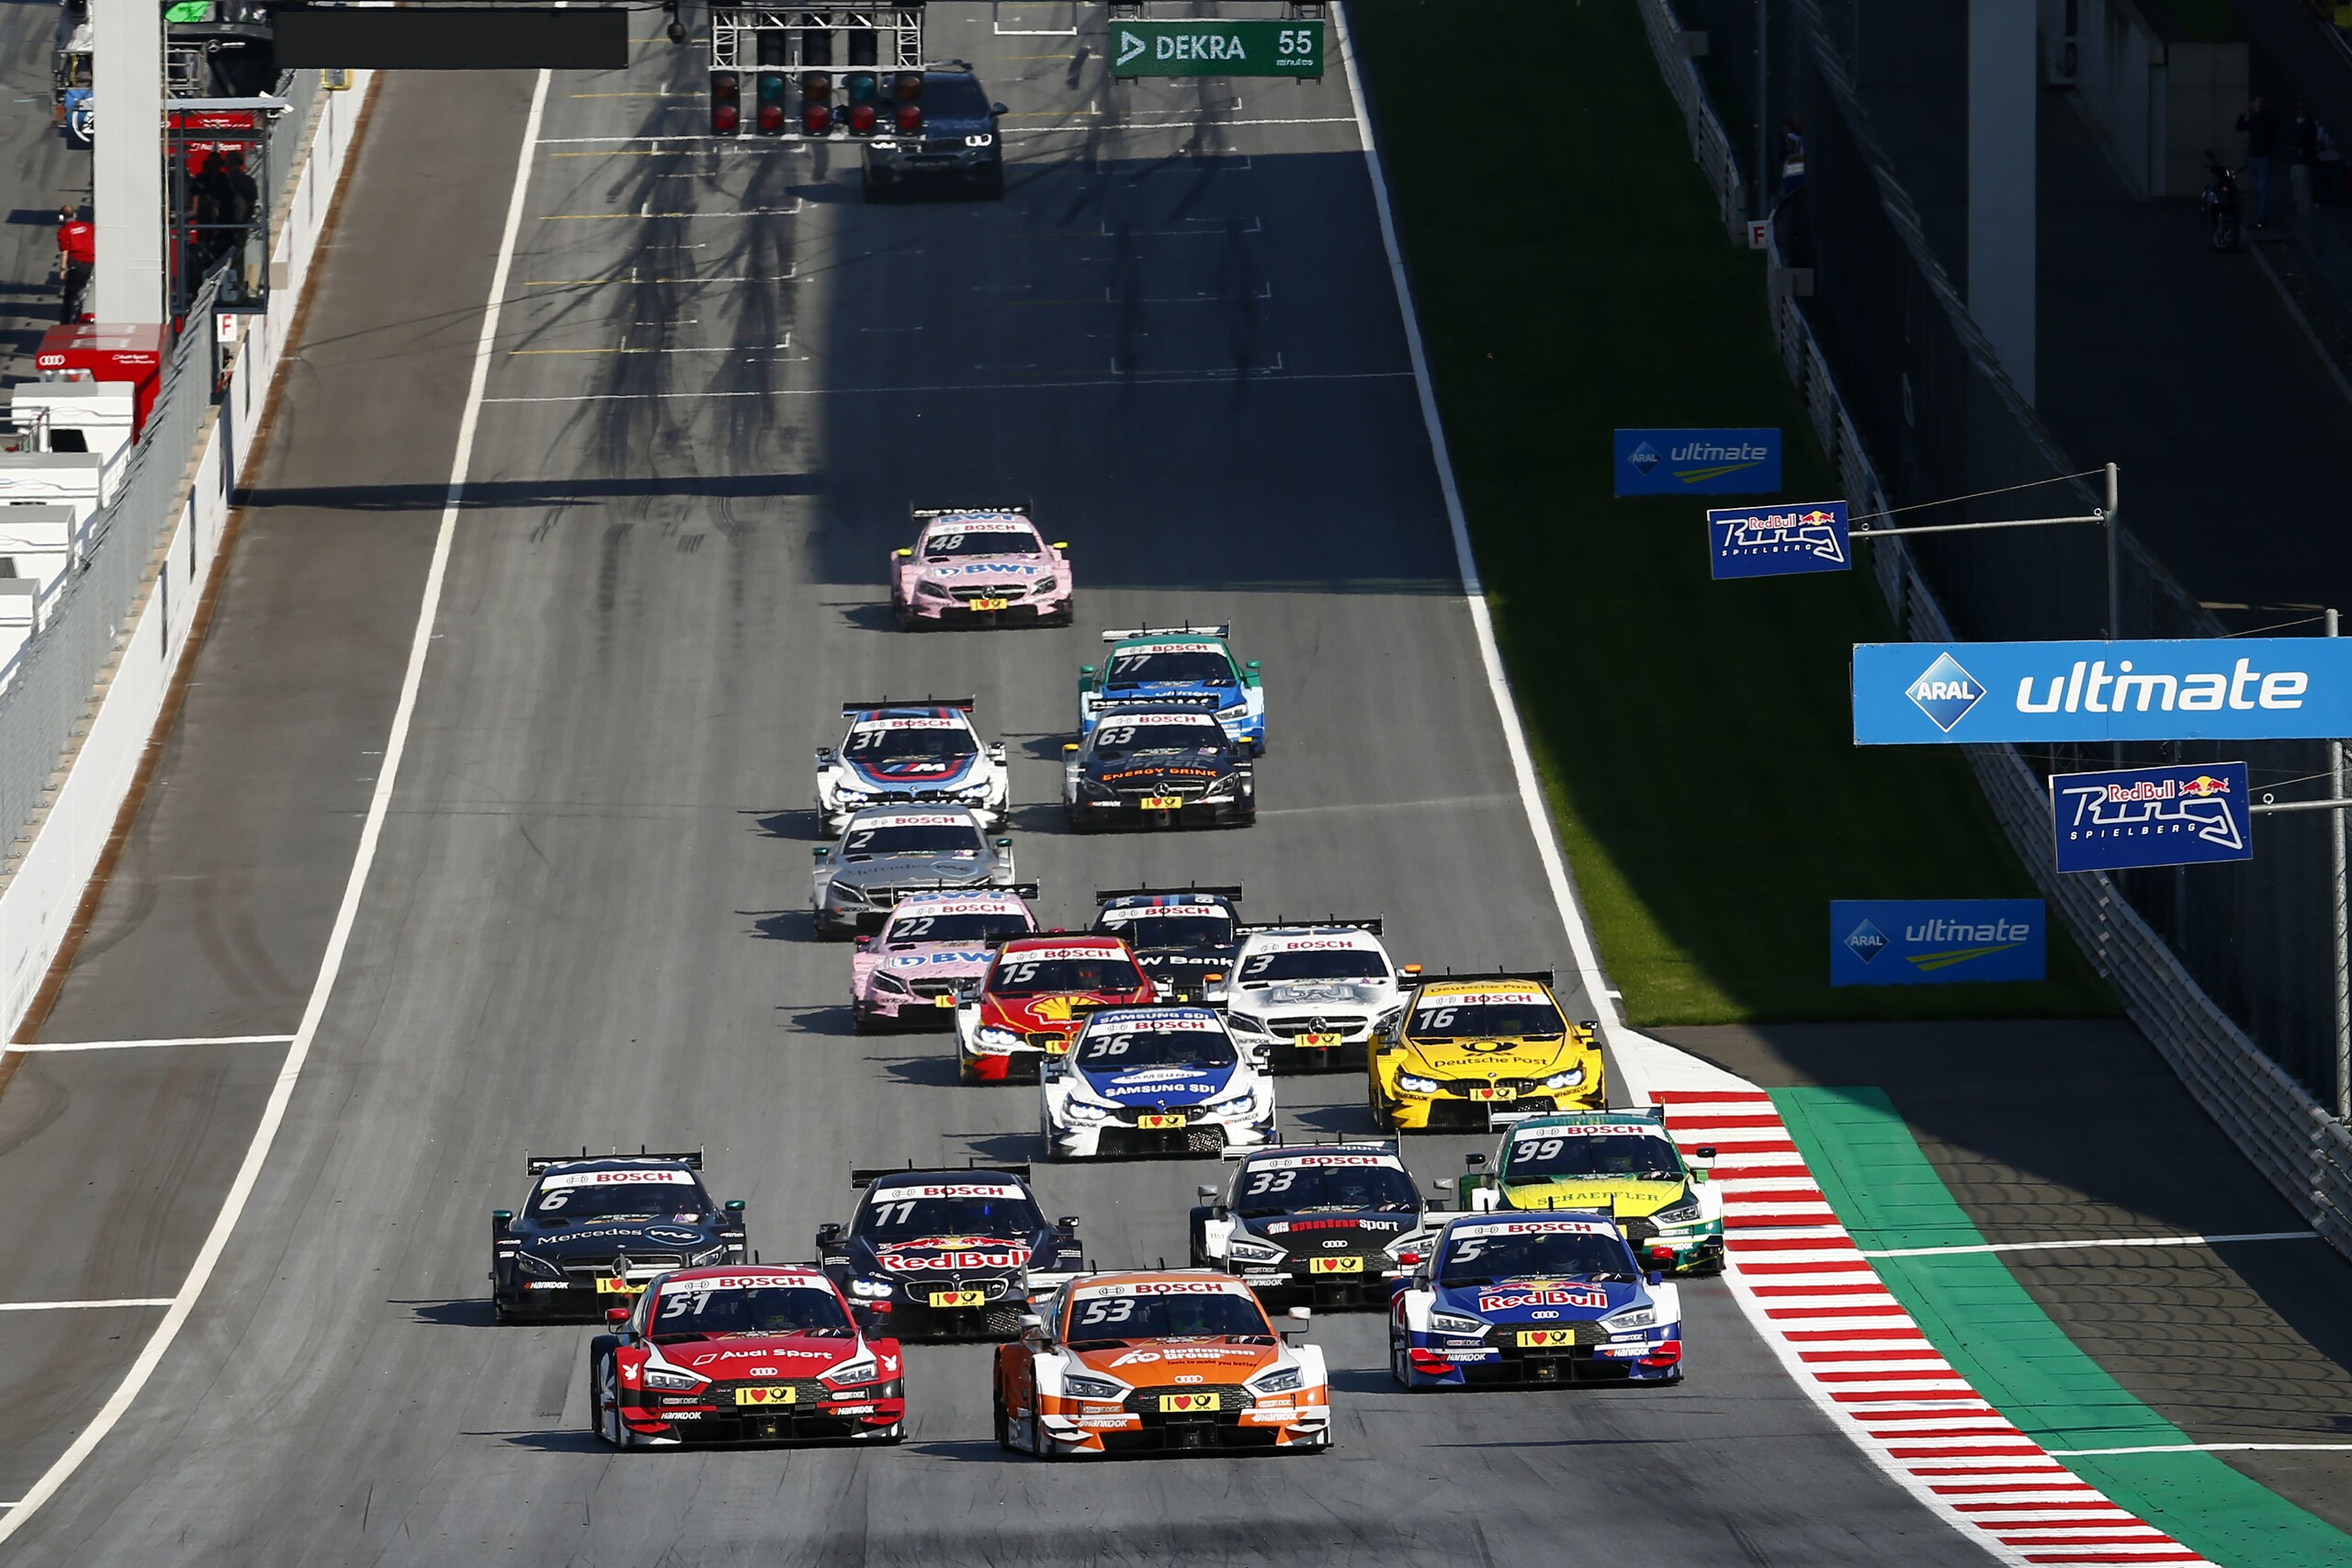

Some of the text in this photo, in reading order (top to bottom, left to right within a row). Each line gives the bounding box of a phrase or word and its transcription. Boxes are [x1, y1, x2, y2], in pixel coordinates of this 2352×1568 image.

[1156, 35, 1246, 60] DEKRA
[1278, 30, 1312, 55] 55
[221, 315, 232, 336] F
[1632, 443, 1768, 463] ARAL ultimate
[1748, 513, 1797, 530] Red Bull
[928, 536, 965, 551] 48
[1722, 544, 1813, 557] SPIELBERG
[1151, 644, 1208, 652] BOSCH
[1114, 655, 1152, 675] 77
[1916, 658, 2309, 714] ARAL ultimate
[891, 719, 951, 728] BOSCH
[1138, 716, 1196, 724] BOSCH
[853, 730, 886, 750] 31
[1098, 727, 1136, 746] 63
[1102, 768, 1219, 782] ENERGY DRINK
[2108, 779, 2176, 803] Red Bull
[895, 817, 956, 825] BOSCH
[2070, 823, 2196, 840] SPIELBERG
[848, 831, 876, 849] 2
[942, 905, 1006, 913] BOSCH
[1145, 907, 1210, 915] BOSCH
[892, 918, 935, 938] 22
[1849, 919, 2030, 946] ARAL ultimate
[1044, 949, 1112, 958] BOSCH
[1287, 941, 1353, 950] BOSCH
[932, 951, 995, 964] BW
[1169, 956, 1235, 968] Bank
[1245, 954, 1275, 974] 3
[1001, 963, 1041, 985] 15
[1430, 984, 1499, 993] Deutsche
[1464, 995, 1532, 1003] BOSCH
[1100, 1011, 1209, 1024] SAMSUNG SDI
[1419, 1008, 1459, 1031] 16
[1135, 1021, 1205, 1031] BOSCH
[1087, 1034, 1134, 1058] 36
[1434, 1056, 1548, 1068] Deutsche Post
[1104, 1084, 1216, 1098] SAMSUNG SDI
[1567, 1126, 1644, 1135] BOSCH
[1513, 1139, 1564, 1163] 99
[596, 1174, 673, 1182] BOSCH
[1247, 1171, 1297, 1195] 33
[923, 1187, 1003, 1196] BOSCH
[539, 1190, 575, 1211] 6
[876, 1201, 917, 1226] 11
[1359, 1219, 1398, 1232] sport
[1508, 1223, 1591, 1233] BOSCH
[537, 1228, 642, 1246] Mercedes
[1451, 1238, 1488, 1263] 5
[876, 1249, 1031, 1271] Red Bull
[719, 1277, 806, 1287] BOSCH
[1136, 1283, 1223, 1294] BOSCH
[661, 1292, 712, 1318] 51
[1479, 1291, 1607, 1311] Red Bull
[1080, 1298, 1136, 1325] 53
[720, 1348, 833, 1359] Audi Sport
[1162, 1348, 1256, 1356] Hoffmann
